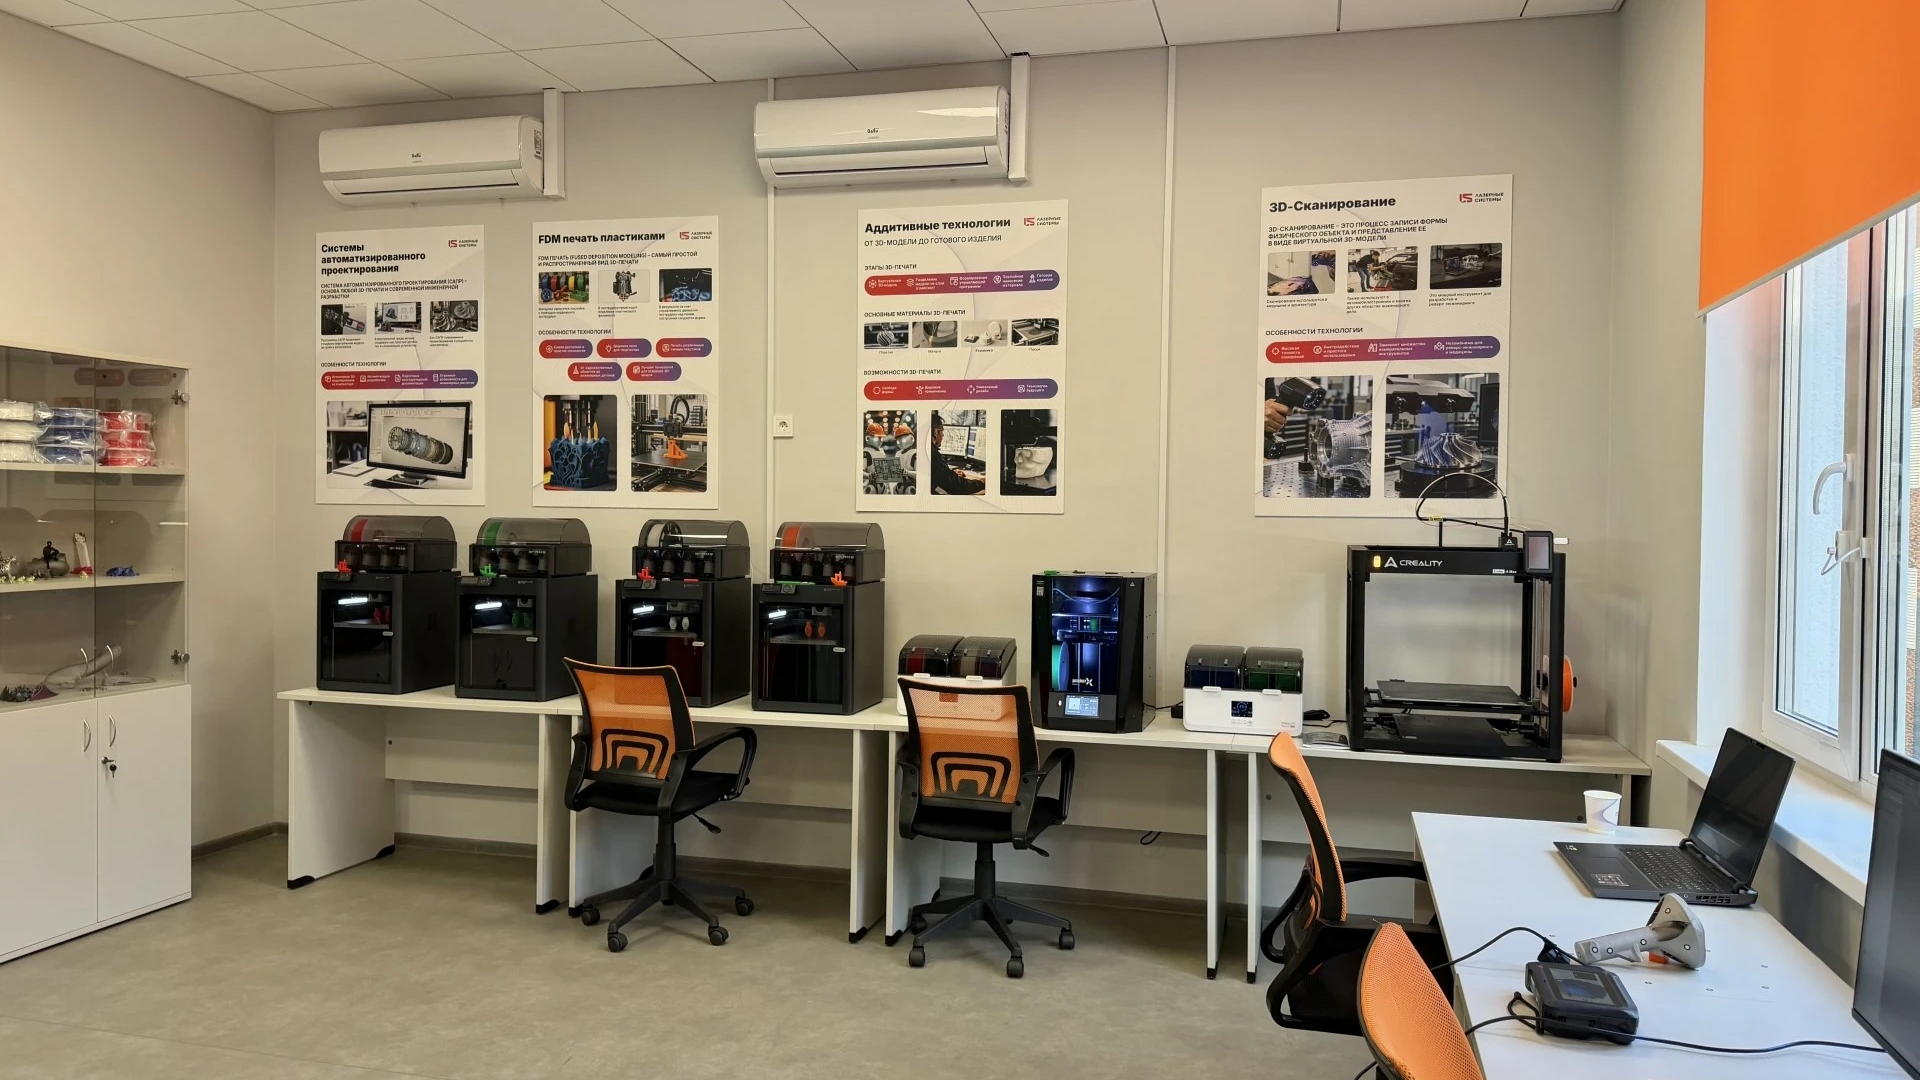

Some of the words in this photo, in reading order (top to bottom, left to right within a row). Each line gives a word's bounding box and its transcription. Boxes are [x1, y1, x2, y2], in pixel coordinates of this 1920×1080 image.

[1269, 197, 1396, 212] 3D-Сканирование
[865, 222, 940, 234] Аддитивные
[941, 219, 1011, 230] технологии
[1268, 223, 1335, 233] 3D-СКАНИРОВАНИЕ
[1268, 231, 1317, 239] ФИЗИЧЕСКОГО
[1318, 229, 1350, 237] ОБЪЕКТА
[1357, 226, 1417, 235] ПРЕДСТАВЛЕНИЕ
[538, 234, 561, 244] FDM
[563, 235, 599, 243] печать
[600, 233, 665, 242] пластиками
[875, 238, 917, 246] 3D-МОДЕЛИ
[930, 236, 966, 244] ГОТОВОГО
[968, 235, 1002, 243] ИЗДЕЛИЯ
[1273, 239, 1292, 247] ВИДЕ
[1293, 237, 1342, 245] ВИРТУАЛЬНОЙ
[321, 244, 364, 253] Системы
[321, 253, 426, 264] автоматизированного
[321, 265, 399, 276] проектирования
[1399, 559, 1443, 567] CREALITY
